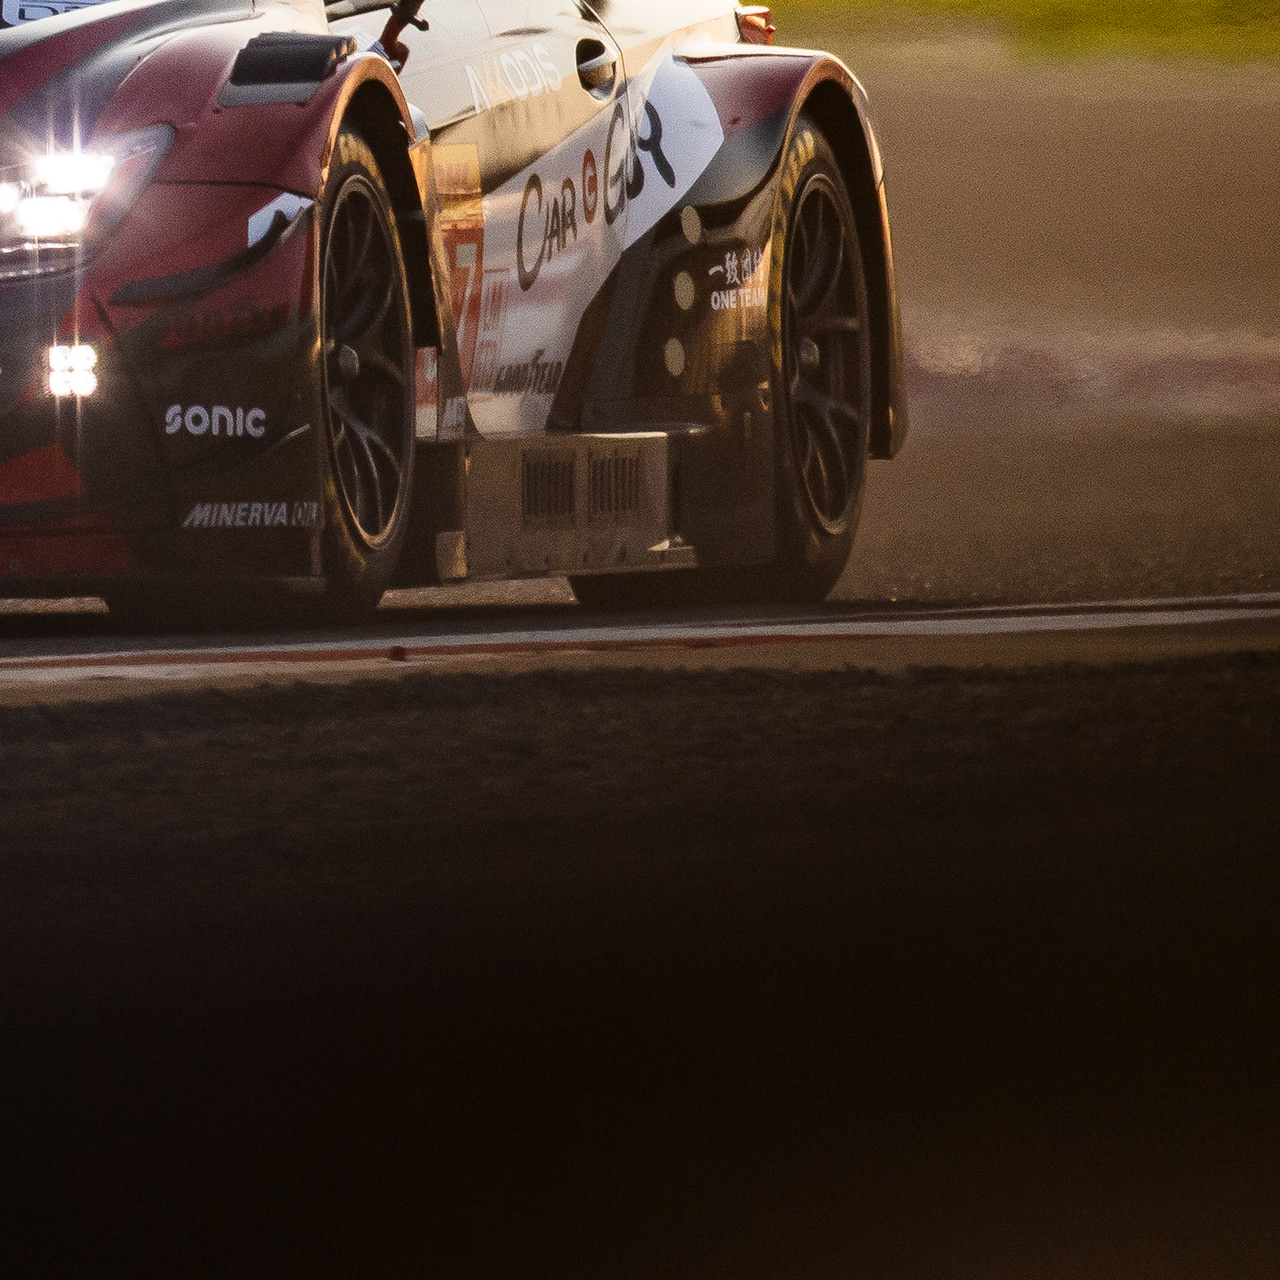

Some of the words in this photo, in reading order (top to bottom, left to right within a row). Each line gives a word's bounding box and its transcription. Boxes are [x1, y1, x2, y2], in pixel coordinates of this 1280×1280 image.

[516, 172, 577, 291] CAR
[710, 289, 737, 311] ONE
[738, 287, 767, 308] TEAM
[182, 502, 288, 528] MINERVA
